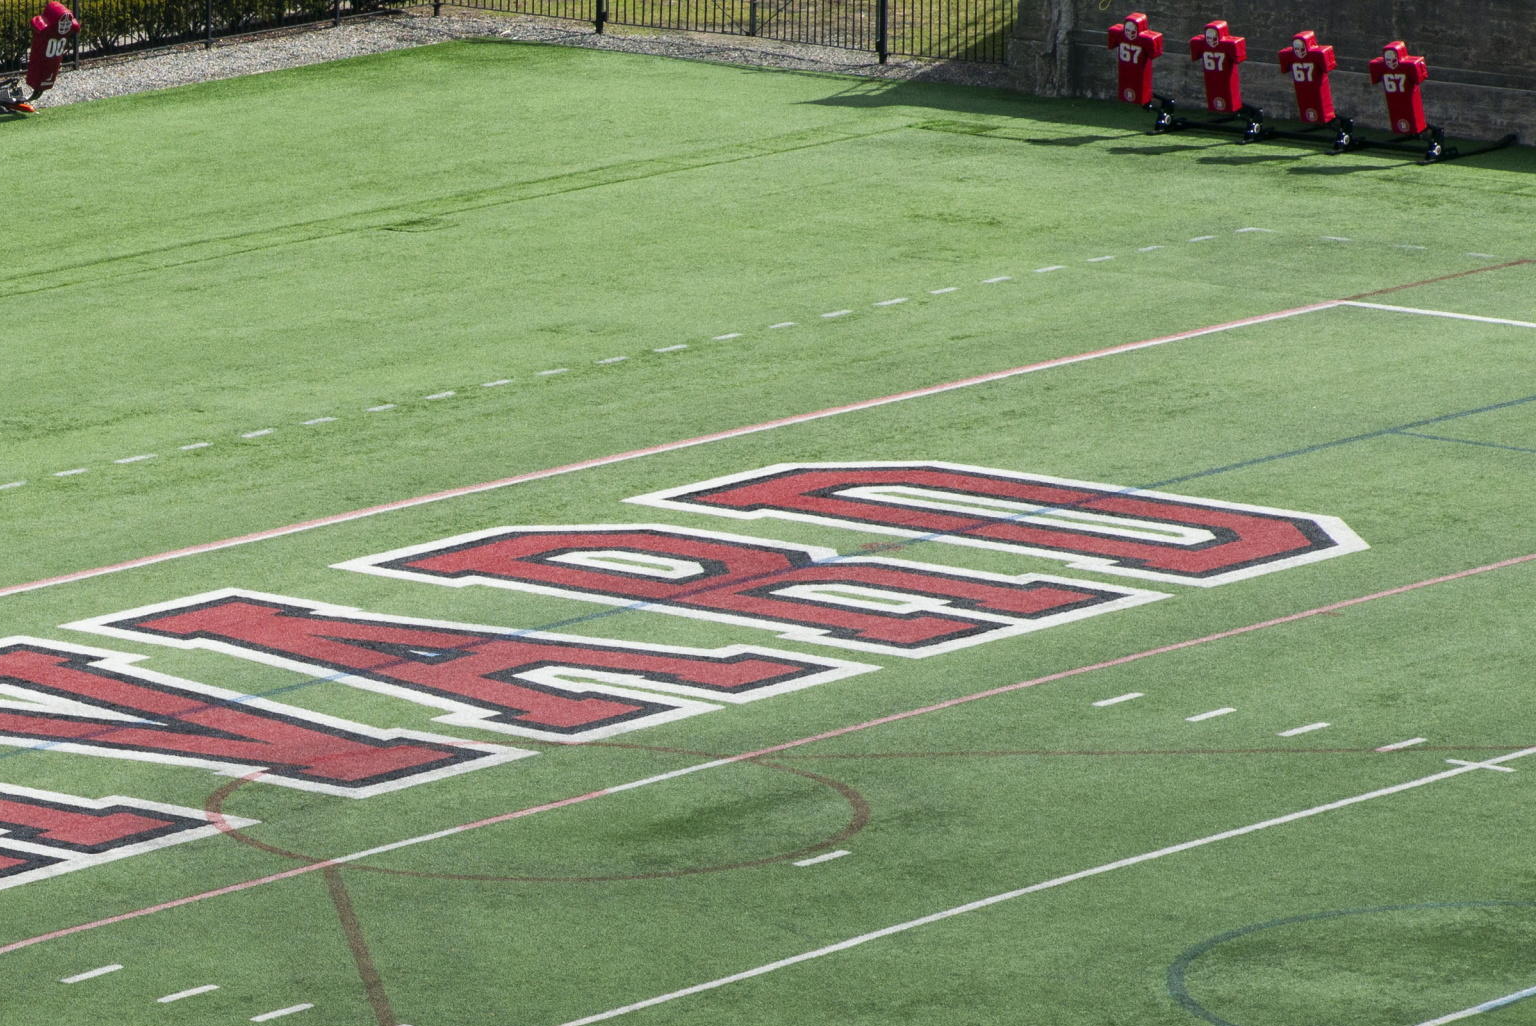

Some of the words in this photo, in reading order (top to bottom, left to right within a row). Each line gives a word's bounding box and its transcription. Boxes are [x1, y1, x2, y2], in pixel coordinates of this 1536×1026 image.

[46, 38, 67, 58] 00
[1119, 41, 1142, 64] 67
[1203, 51, 1226, 72] 67
[1292, 63, 1314, 83] 67
[1383, 73, 1406, 93] 67
